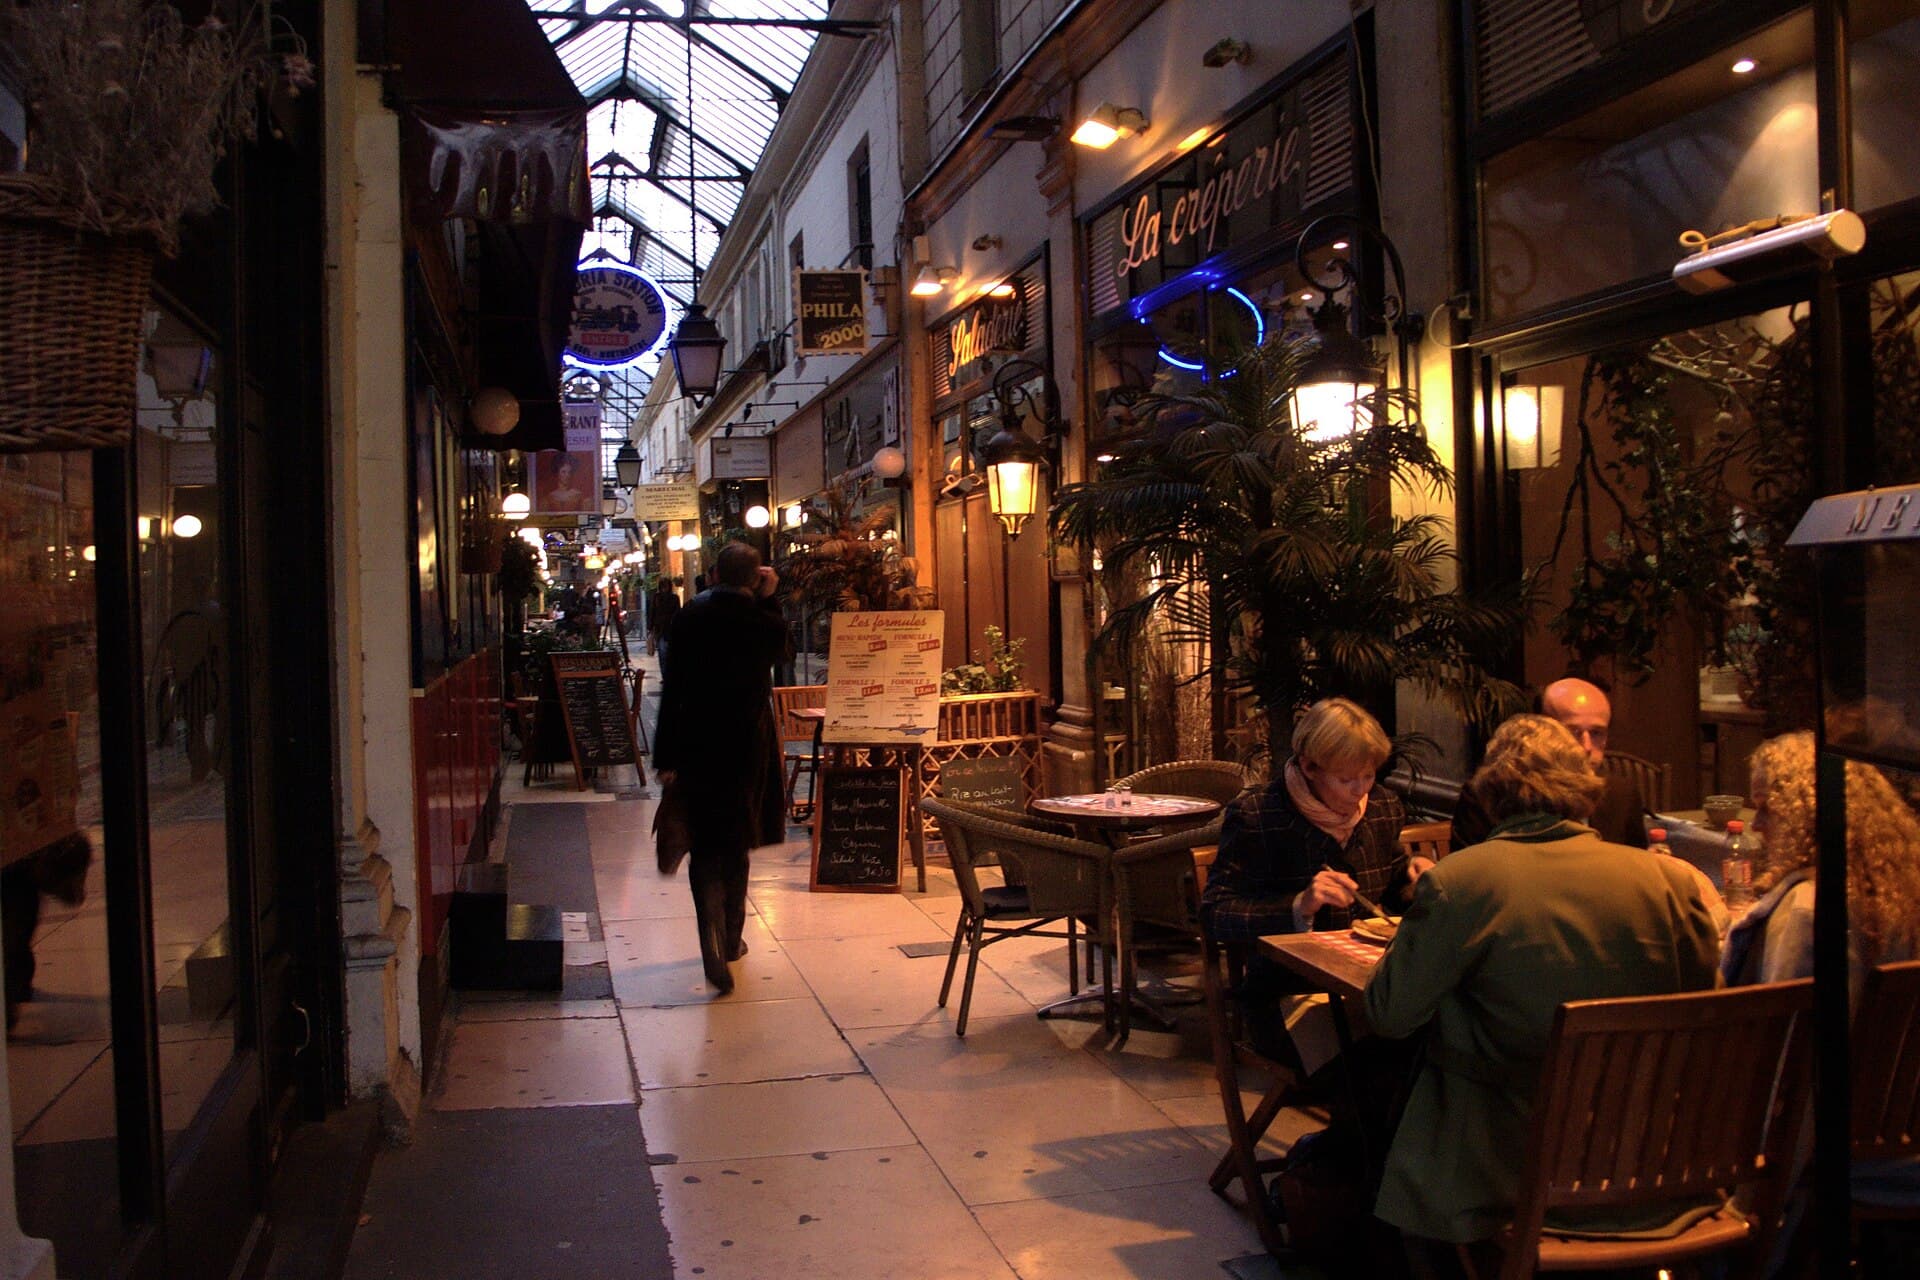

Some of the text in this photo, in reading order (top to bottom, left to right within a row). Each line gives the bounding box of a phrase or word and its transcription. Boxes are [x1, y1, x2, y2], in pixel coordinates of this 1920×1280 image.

[1117, 193, 1163, 277] La
[614, 270, 663, 315] STATION
[802, 303, 864, 319] PHILA
[820, 323, 864, 349] 2000
[847, 613, 928, 632] Les formules
